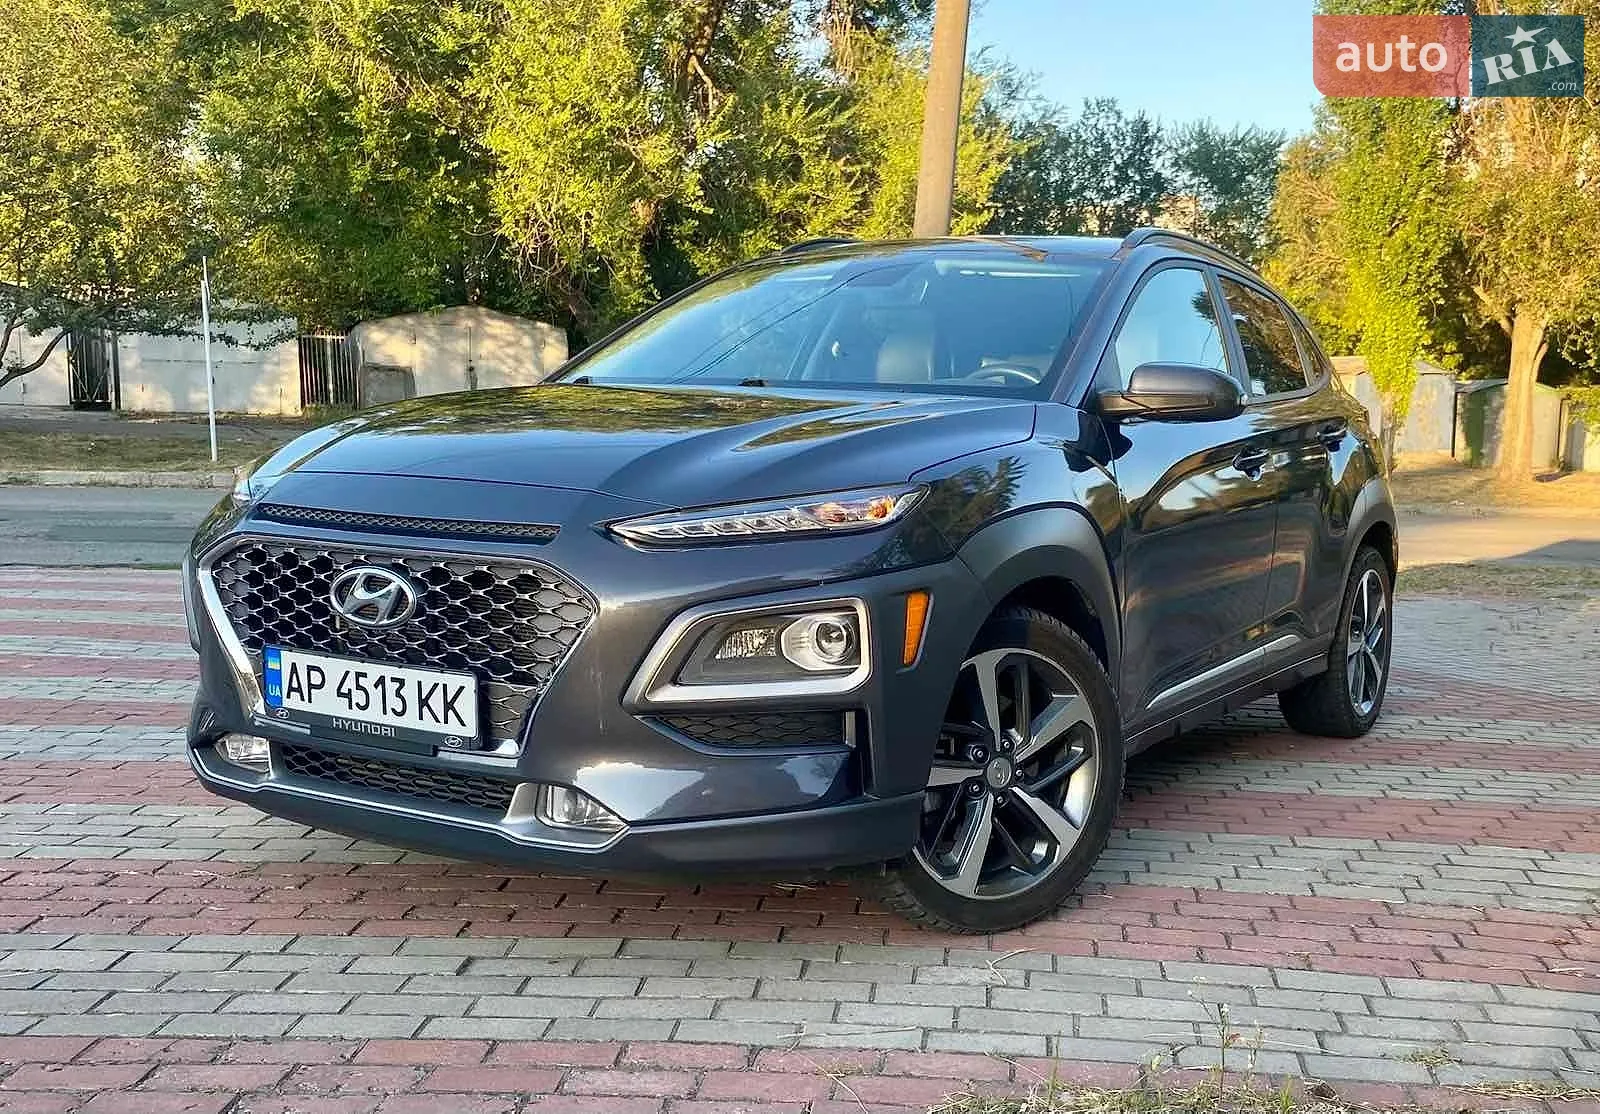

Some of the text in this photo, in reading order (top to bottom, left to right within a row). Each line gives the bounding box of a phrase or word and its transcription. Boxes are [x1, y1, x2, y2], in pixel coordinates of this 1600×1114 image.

[269, 684, 281, 697] UA
[286, 662, 467, 728] AP 4513 KK
[332, 717, 397, 737] HYUNDAI
